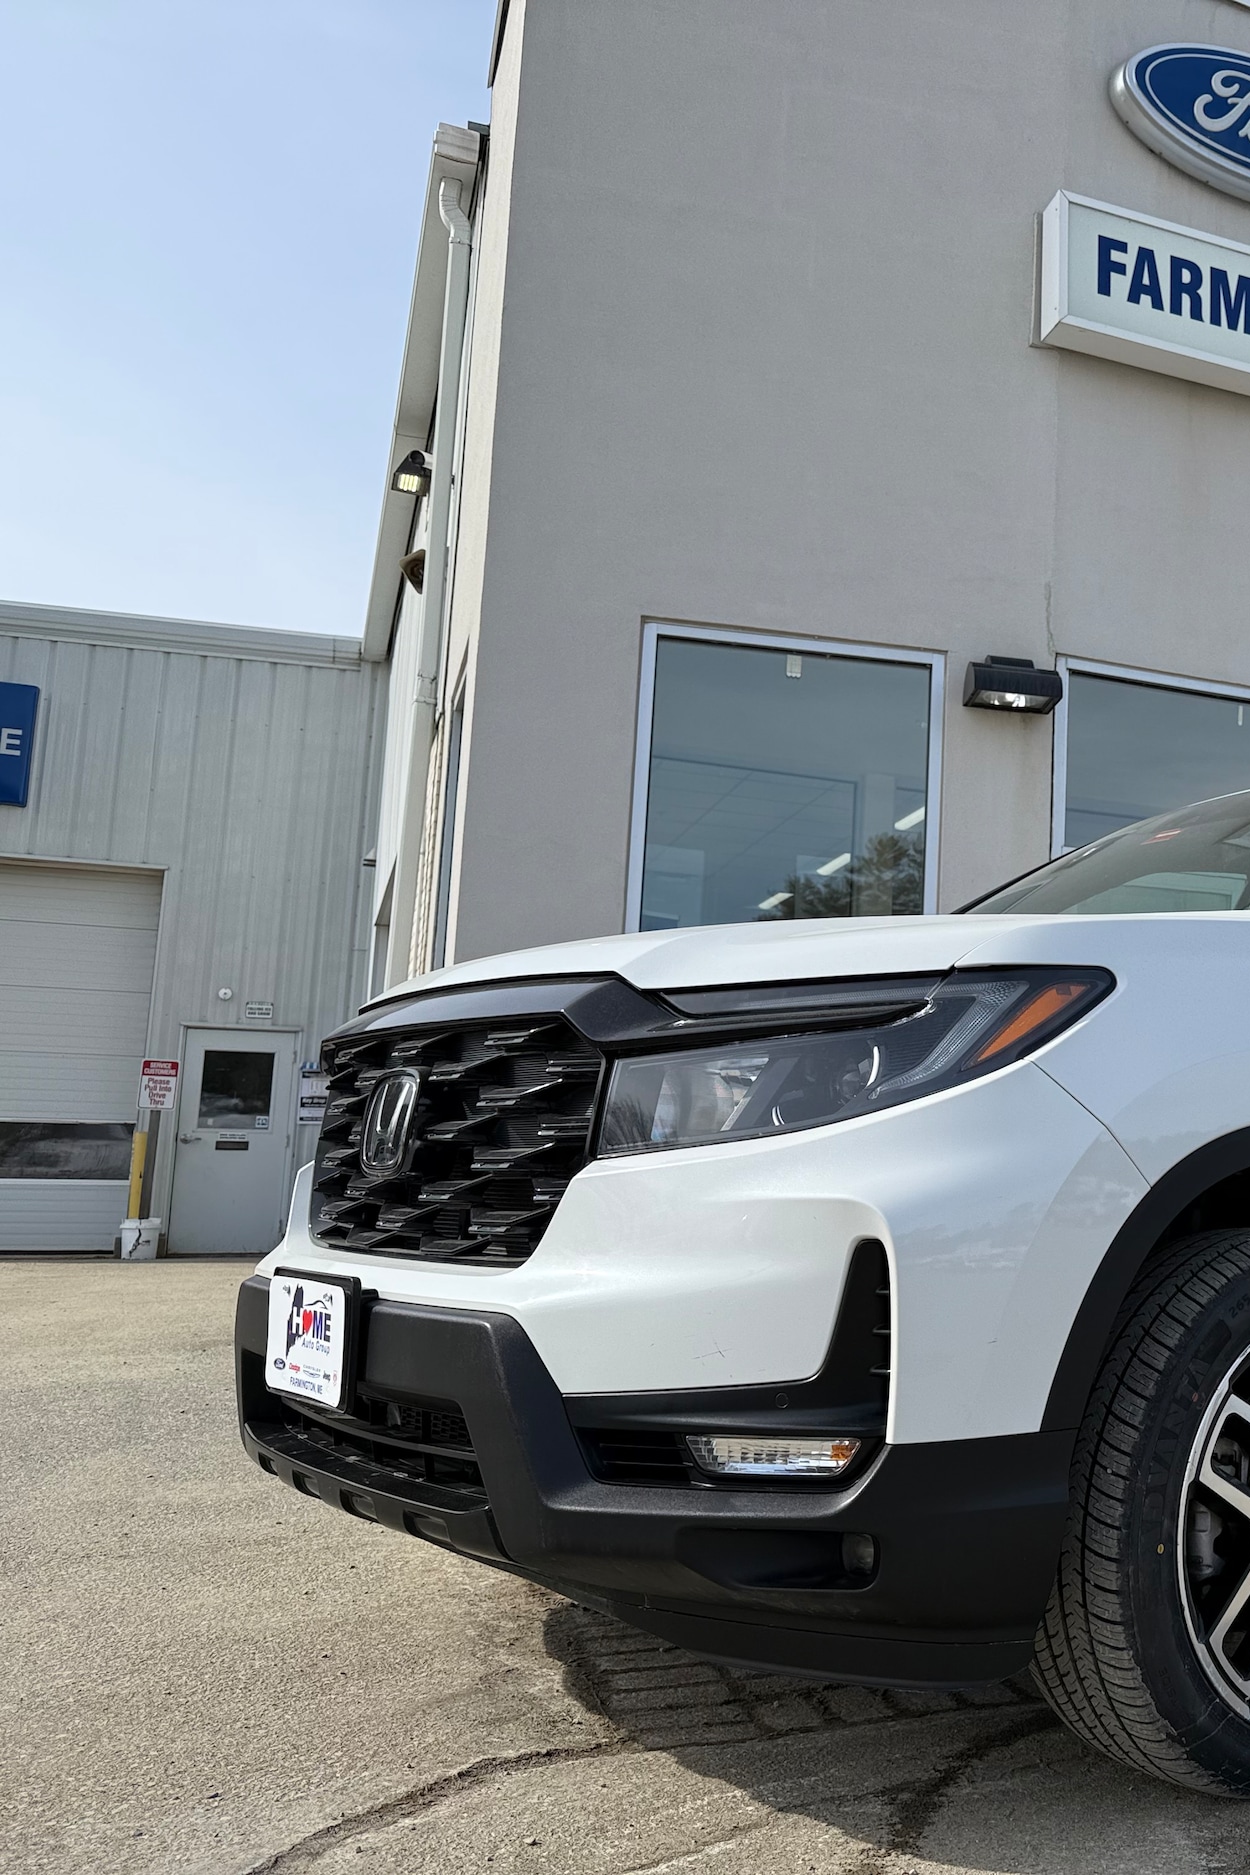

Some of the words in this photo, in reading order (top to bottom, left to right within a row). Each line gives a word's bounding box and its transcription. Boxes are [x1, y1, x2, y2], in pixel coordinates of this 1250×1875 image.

[143, 1068, 177, 1076] CUSTOMERS
[147, 1077, 170, 1085] Please
[148, 1091, 166, 1099] Drive
[302, 1338, 314, 1350] Auto
[315, 1340, 331, 1356] Group
